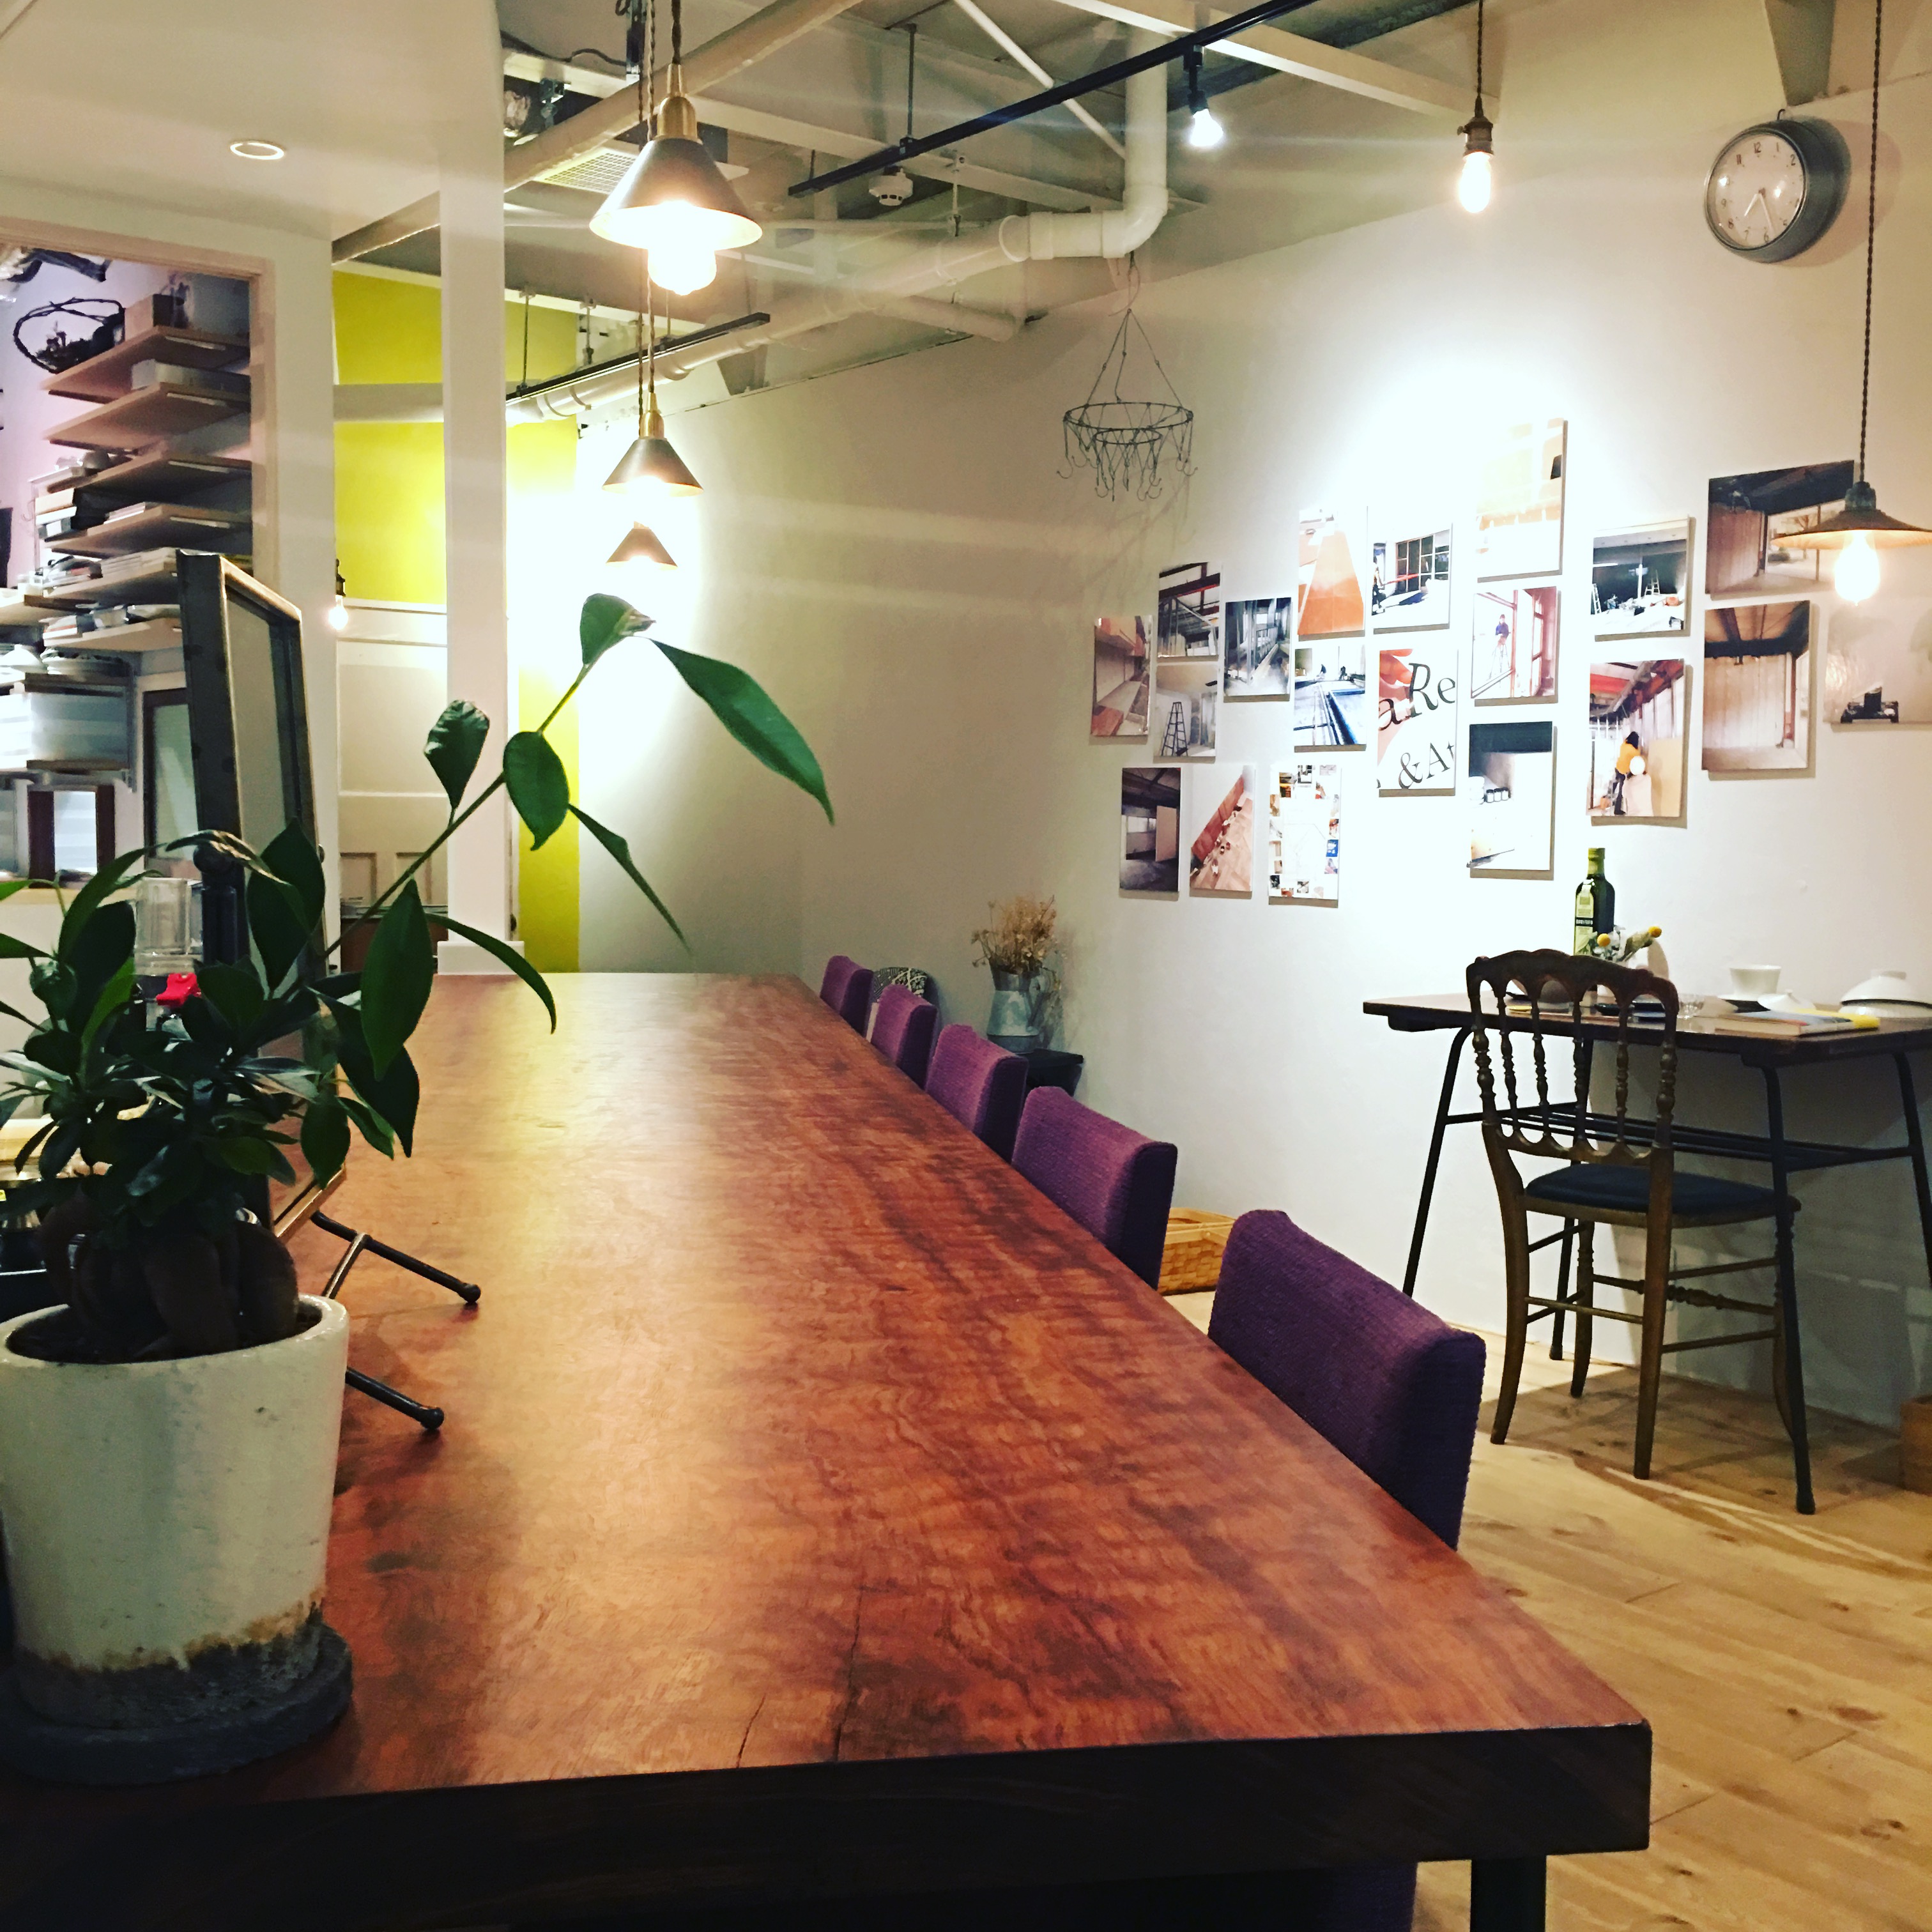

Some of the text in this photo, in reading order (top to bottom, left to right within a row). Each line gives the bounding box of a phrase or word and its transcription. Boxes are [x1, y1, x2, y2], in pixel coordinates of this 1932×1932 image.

[1753, 142, 1761, 153] 12
[1790, 154, 1796, 165] 2
[1721, 198, 1726, 208] 9
[1744, 230, 1749, 240] 7
[1764, 231, 1769, 241] 6
